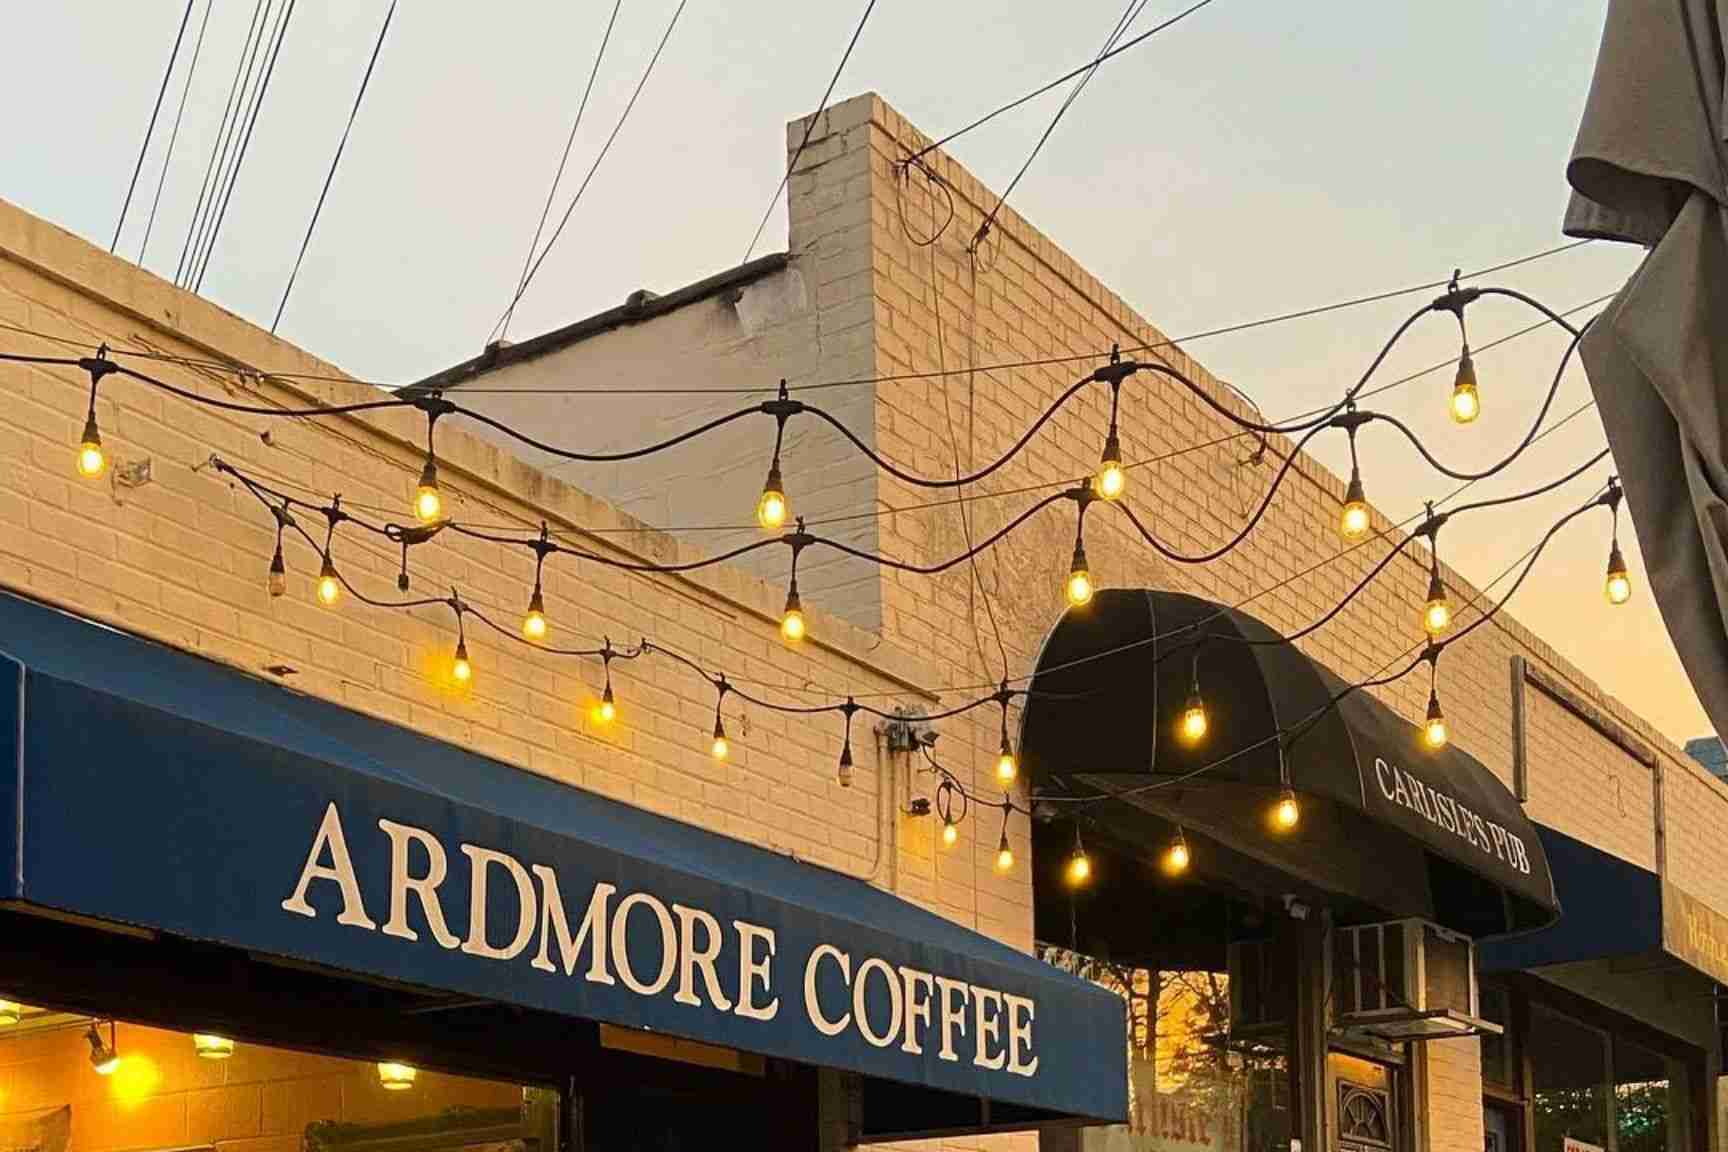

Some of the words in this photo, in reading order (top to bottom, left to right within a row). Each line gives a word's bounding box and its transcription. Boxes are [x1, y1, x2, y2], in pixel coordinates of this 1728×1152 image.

[1487, 820, 1531, 875] PUB
[281, 801, 779, 1021] ARDMORE
[804, 943, 1038, 1077] COFFEE
